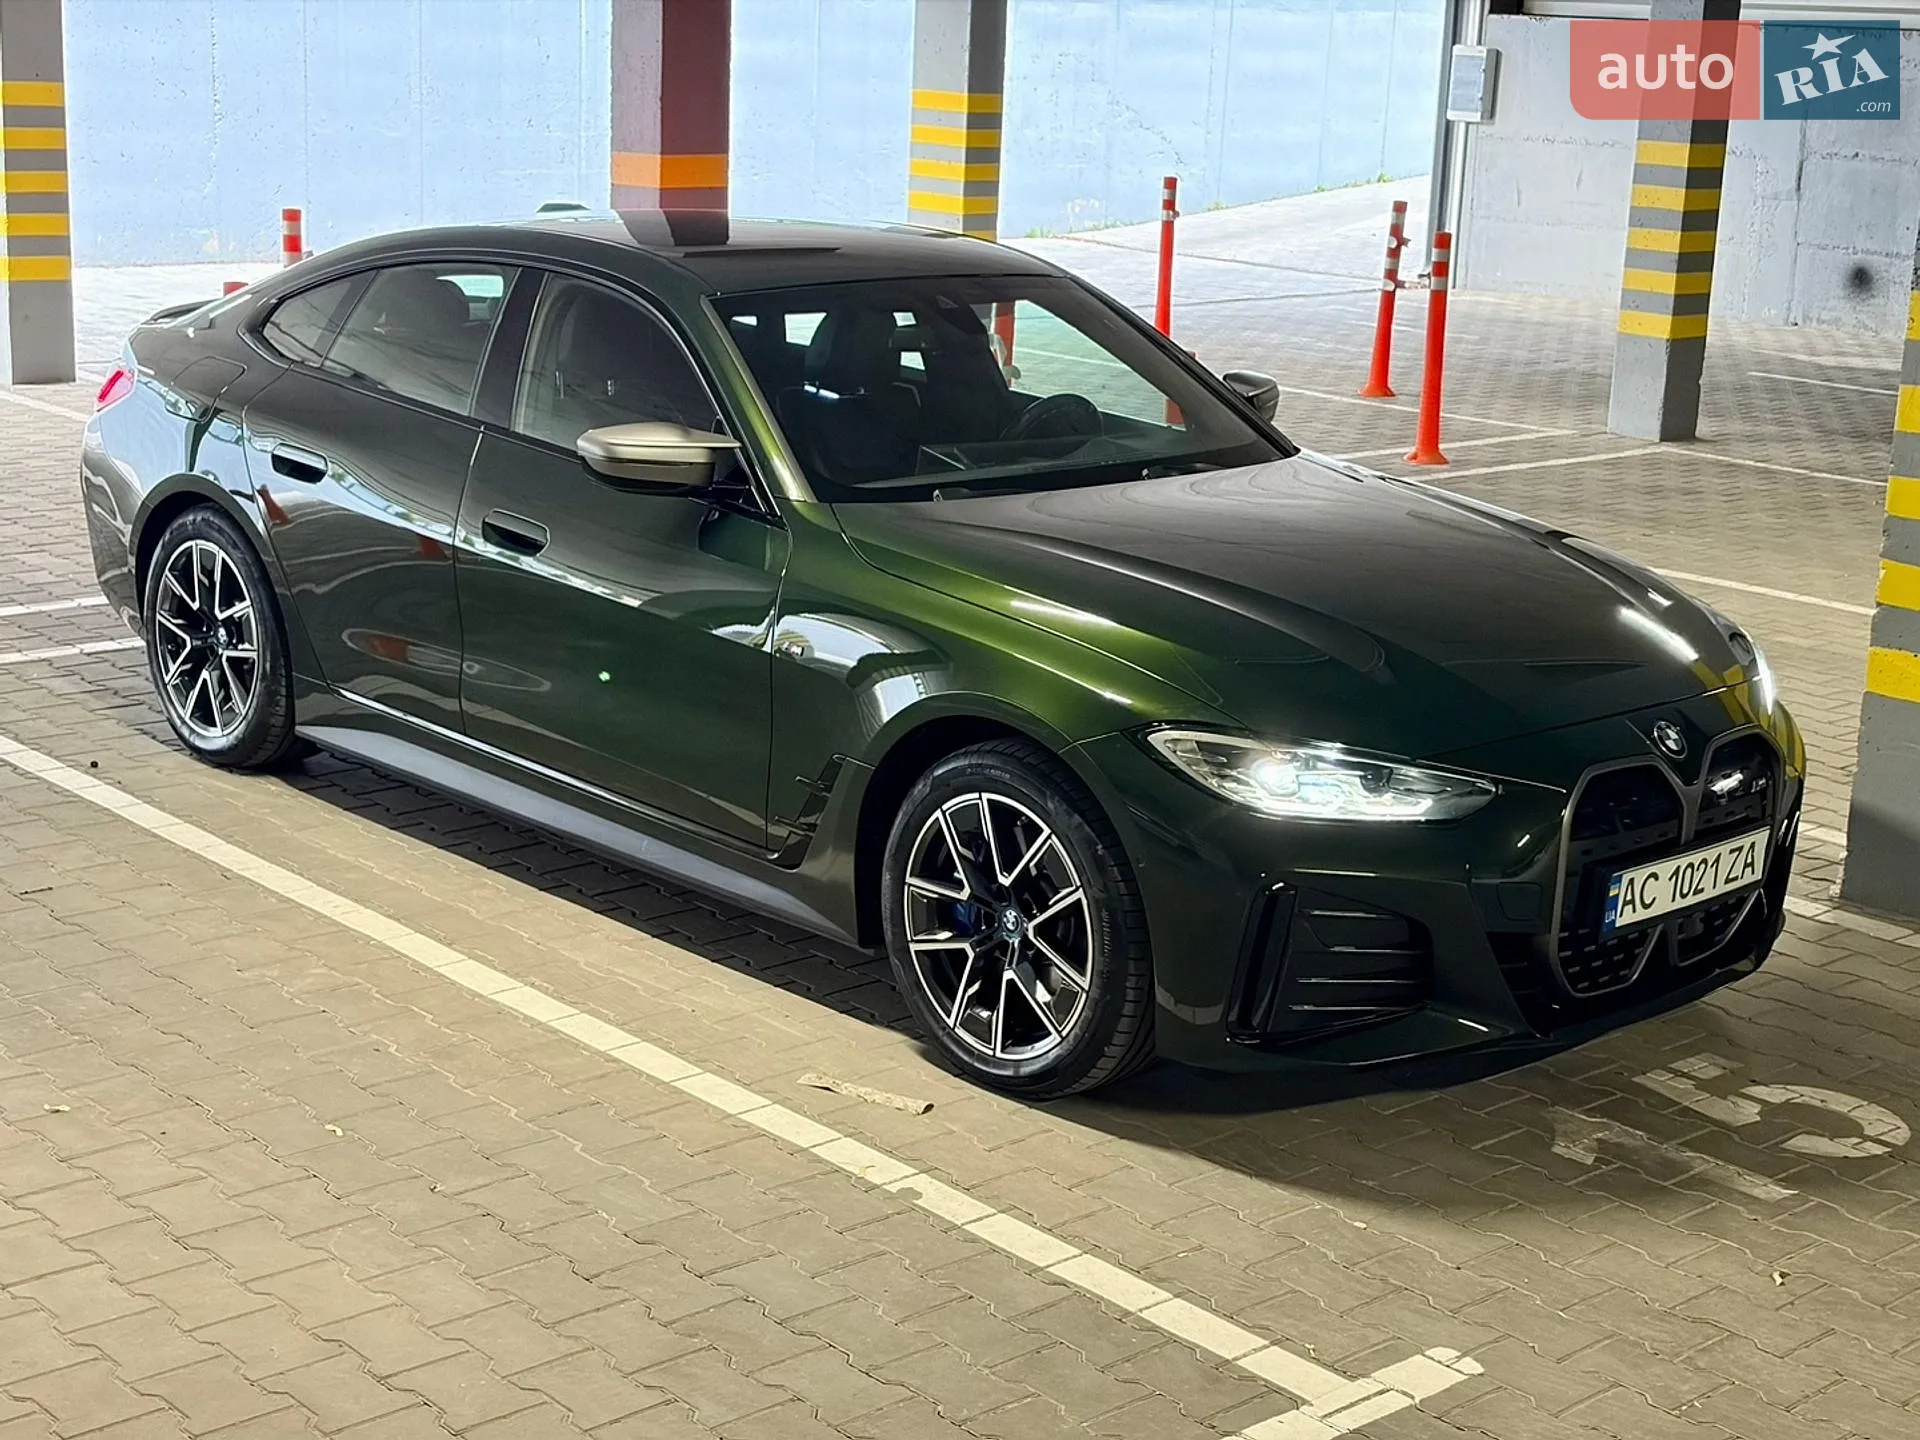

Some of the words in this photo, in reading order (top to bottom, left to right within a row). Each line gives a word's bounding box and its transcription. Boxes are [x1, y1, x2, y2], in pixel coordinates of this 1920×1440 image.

[1618, 871, 1659, 919] AC
[1667, 852, 1722, 903] 1021
[1724, 841, 1757, 885] ZA
